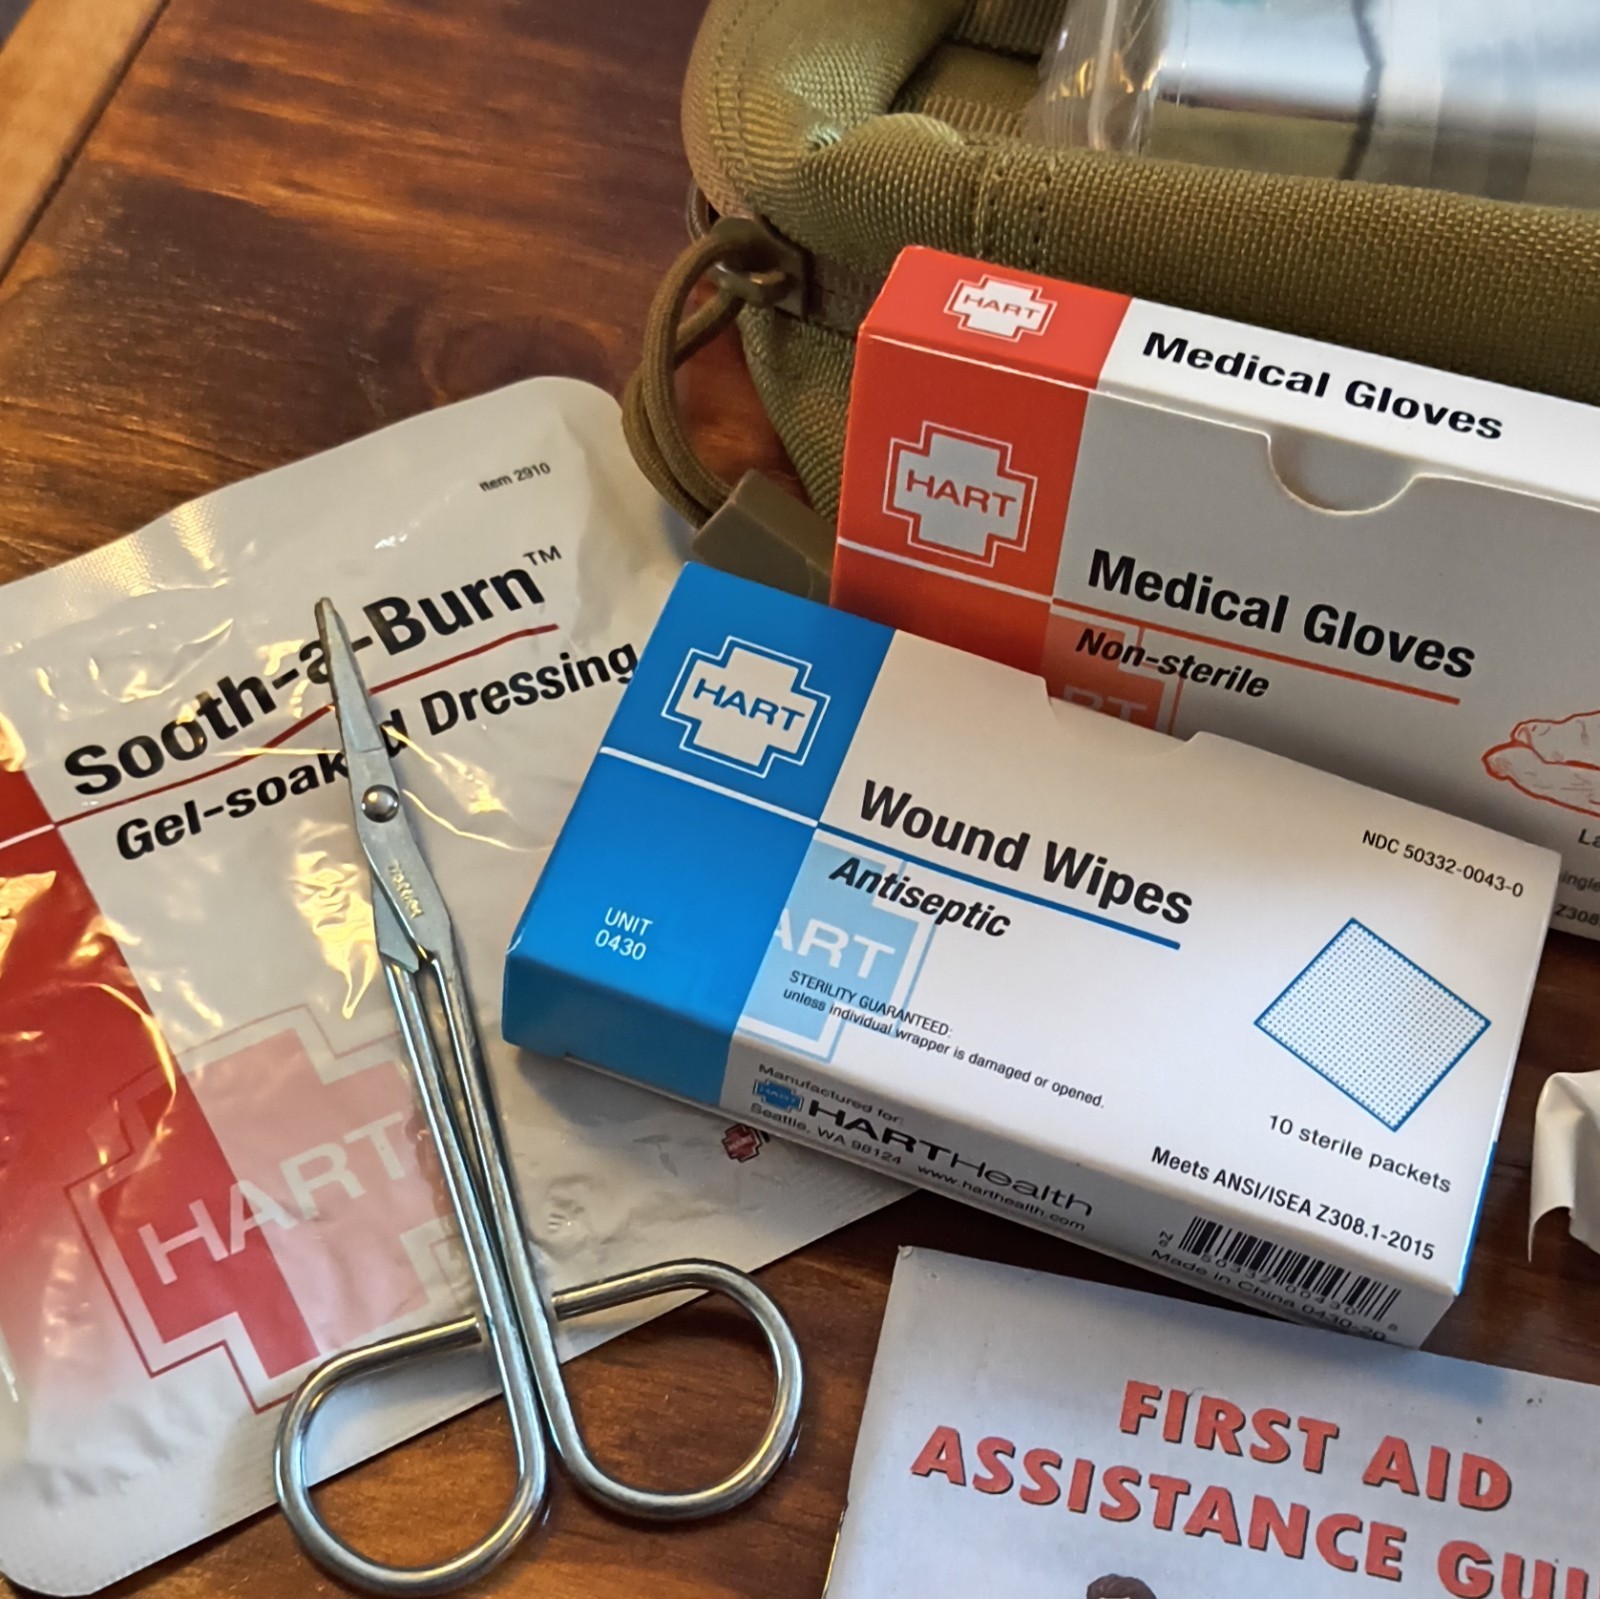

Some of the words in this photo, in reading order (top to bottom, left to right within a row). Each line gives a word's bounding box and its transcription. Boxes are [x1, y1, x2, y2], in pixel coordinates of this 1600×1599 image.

[964, 293, 1041, 320] HART
[1143, 332, 1330, 397] Medical
[1345, 380, 1503, 440] Gloves
[513, 462, 551, 481] 2910
[906, 470, 1016, 517] HART
[1088, 549, 1289, 633] Medical
[1304, 604, 1475, 678] Gloves
[420, 643, 638, 735] Dressing
[1076, 628, 1269, 697] Non-sterile
[692, 678, 806, 731] HART
[116, 709, 408, 860] Gel-soakd
[860, 779, 1031, 872] Wound
[1043, 840, 1193, 925] Wipes
[1362, 829, 1400, 854] NDC
[1403, 844, 1524, 898] 50332-0043-0
[1560, 871, 1600, 892] ingle
[604, 907, 653, 937] UNIT
[829, 857, 1012, 937] Antiseptic
[595, 929, 646, 961] 0430
[789, 970, 858, 1004] STERILITY
[859, 995, 953, 1038] GUARANTEED:
[783, 987, 826, 1012] unless
[829, 1002, 893, 1035] individual
[895, 1026, 950, 1055] wrapper
[953, 1046, 965, 1061] is
[968, 1053, 1032, 1083] damaged
[1034, 1075, 1050, 1088] or
[1051, 1081, 1105, 1108] opened.
[758, 1063, 874, 1113] Manufactured
[751, 1102, 812, 1134] Seattle,
[817, 1126, 846, 1146] WA
[1269, 1114, 1294, 1136] 10
[1299, 1127, 1364, 1161] sterile
[1368, 1151, 1451, 1193] packets
[138, 1112, 409, 1286] HART
[917, 1164, 1085, 1232] www.harthealth.com
[1151, 1146, 1210, 1181] Meets
[1213, 1169, 1312, 1217] ANSI/ISEA
[1315, 1203, 1436, 1261] Z308.1-2015
[1151, 1249, 1207, 1277] Made
[1214, 1271, 1232, 1285] in
[1238, 1280, 1296, 1309] China
[1120, 1379, 1338, 1475] FIRST
[1362, 1435, 1512, 1512] AID
[911, 1424, 1406, 1582] ASSISTANCE
[1437, 1539, 1600, 1599] GUI
